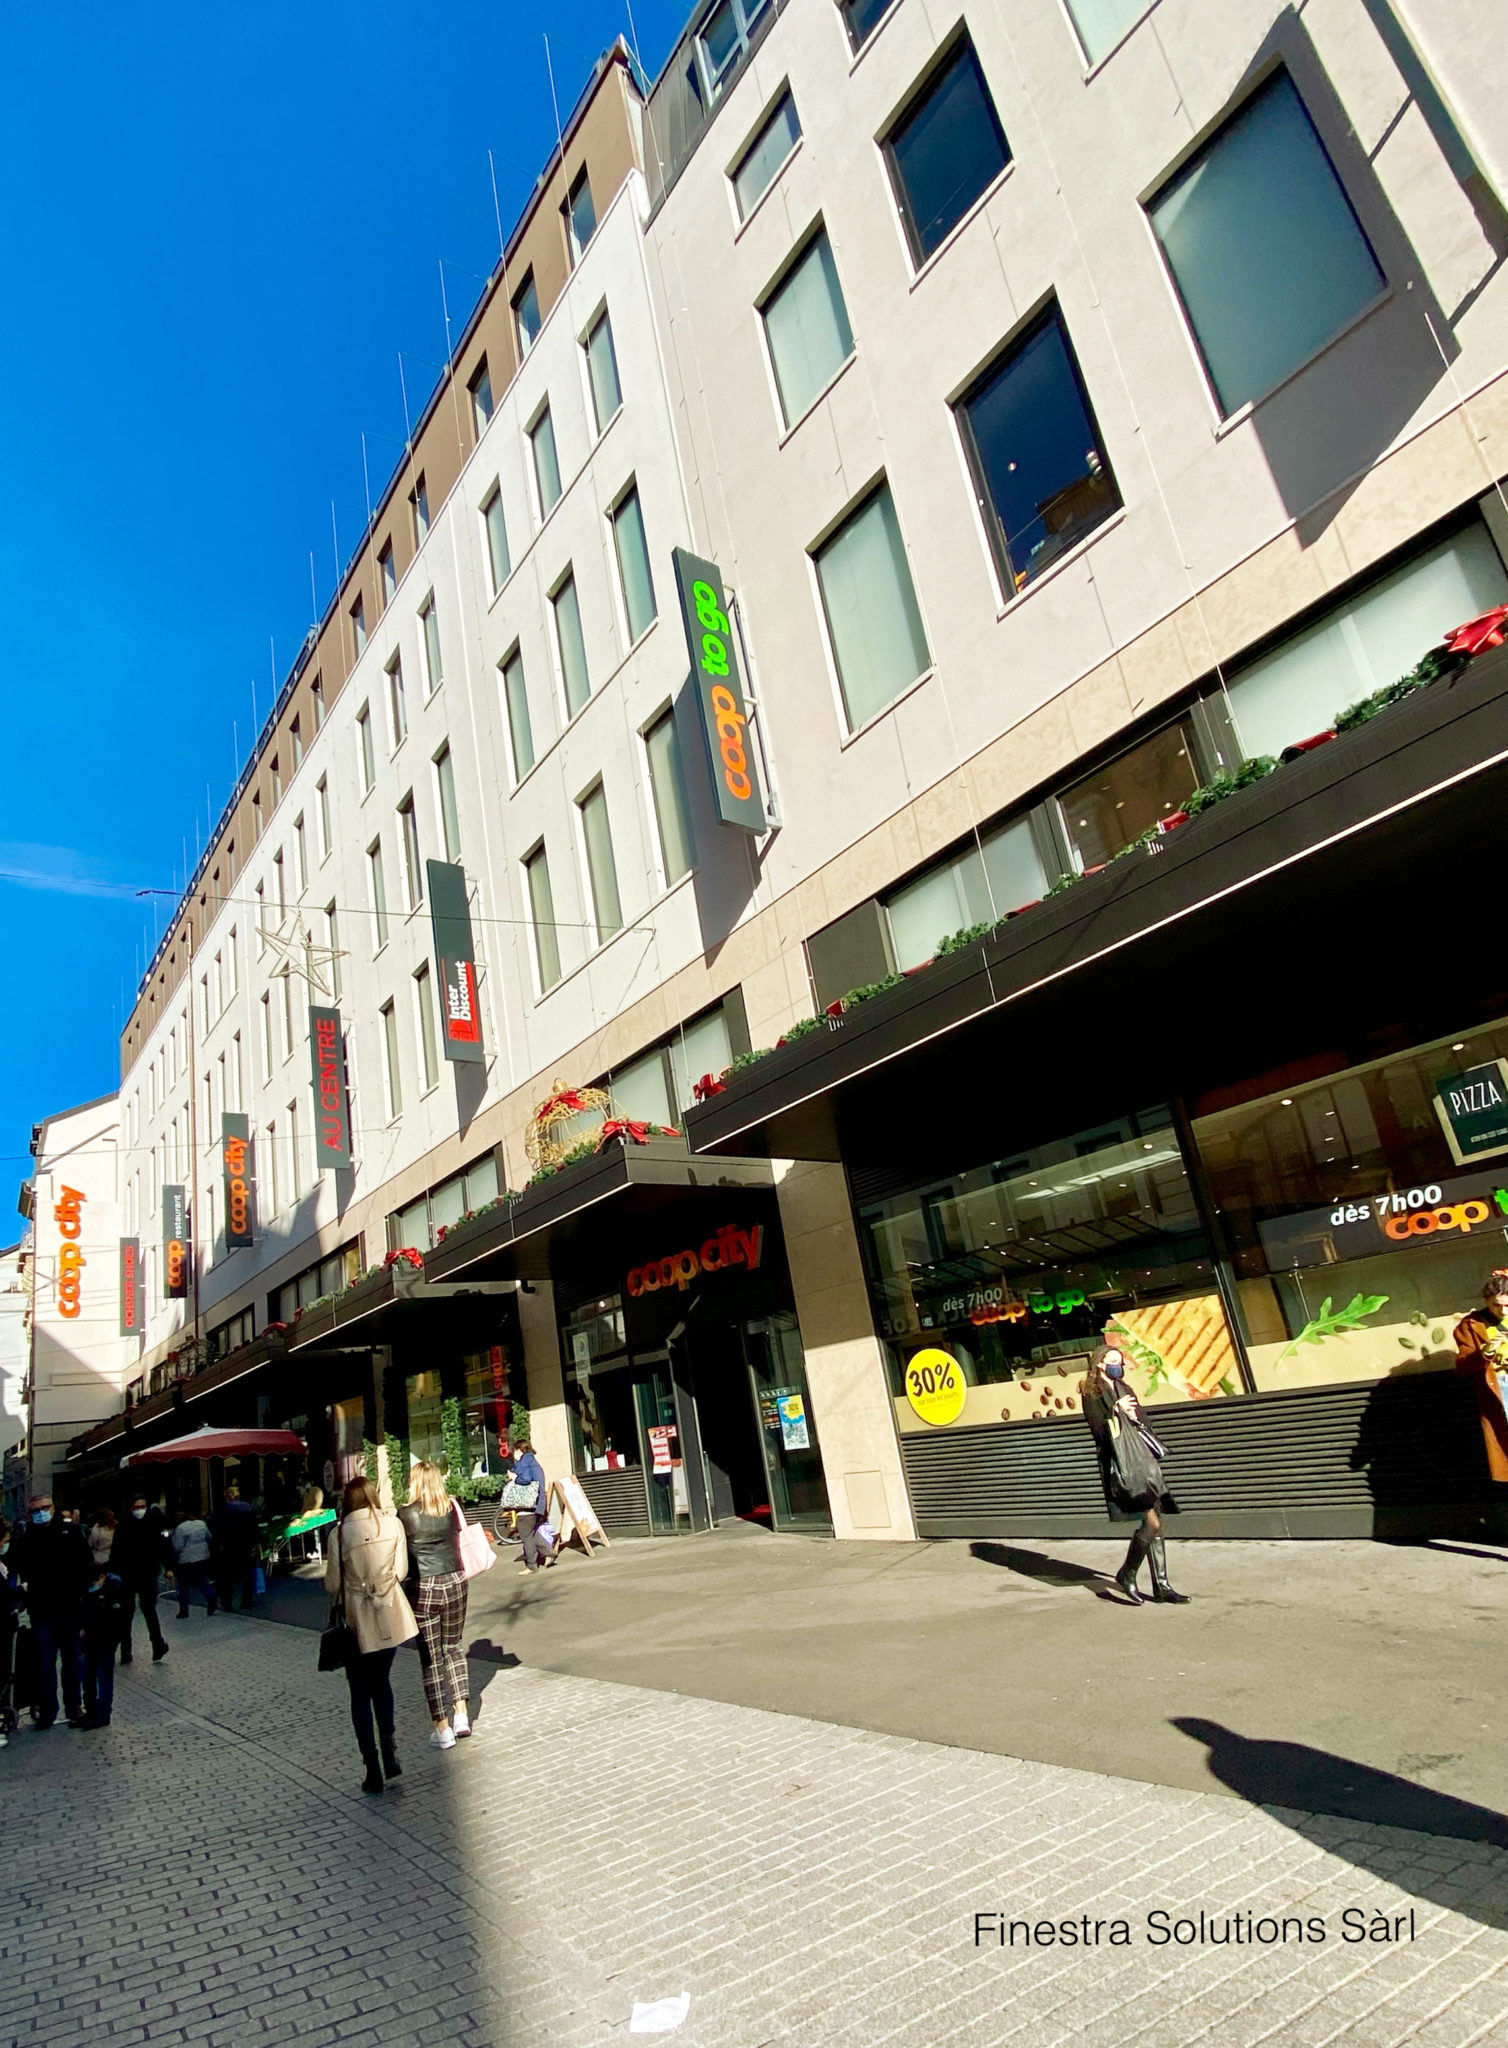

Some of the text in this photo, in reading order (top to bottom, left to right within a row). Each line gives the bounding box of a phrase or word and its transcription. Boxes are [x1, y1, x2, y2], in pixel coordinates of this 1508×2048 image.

[692, 579, 752, 800] coop to go
[448, 984, 460, 1019] Inter
[455, 960, 472, 1021] Discount
[316, 1018, 343, 1152] AU CENTRE
[1449, 1080, 1502, 1116] PIZZA
[225, 1135, 249, 1234] coop city
[1330, 1184, 1442, 1226] dès 7h00
[174, 1194, 182, 1239] restaurant
[1385, 1200, 1490, 1241] coop
[54, 1184, 88, 1318] coop city
[167, 1240, 186, 1288] coop
[626, 1223, 764, 1298] coop city
[942, 1287, 1003, 1312] dès 7h00
[970, 1289, 1085, 1326] coop to go
[908, 1362, 955, 1398] 30%
